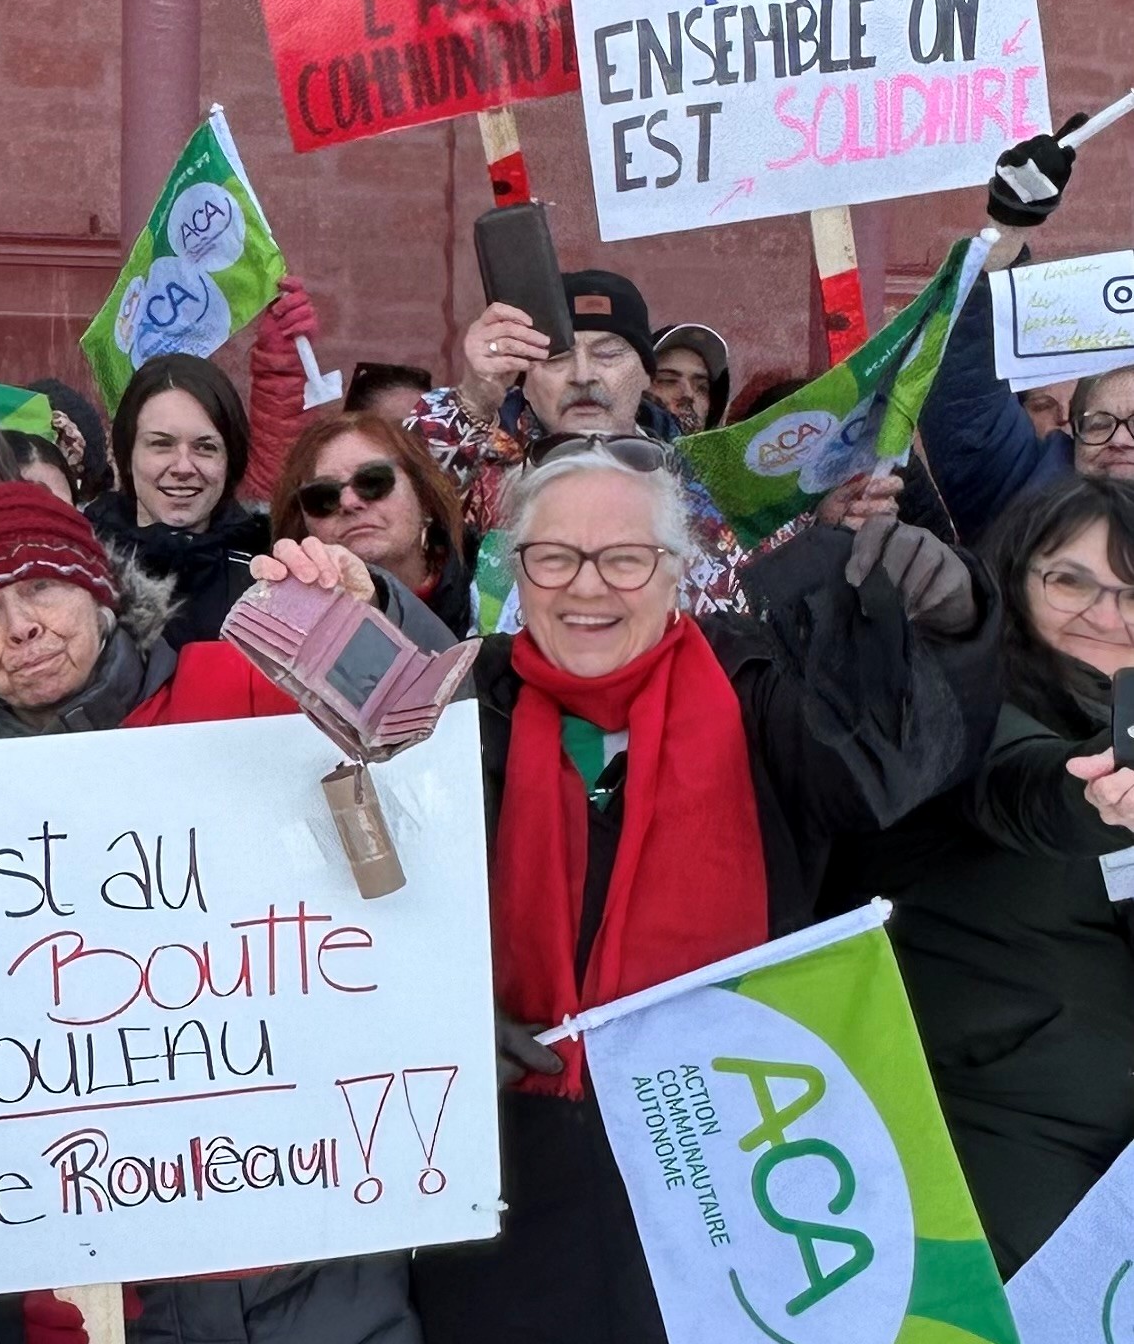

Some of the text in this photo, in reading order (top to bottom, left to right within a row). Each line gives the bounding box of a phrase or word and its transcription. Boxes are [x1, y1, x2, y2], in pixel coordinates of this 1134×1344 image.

[611, 66, 1042, 193] EST SOLIDAIRE
[179, 199, 226, 249] ACA
[100, 826, 210, 915] au
[8, 901, 380, 1026] Boutte
[631, 1076, 686, 1191] AUTONOME
[656, 1069, 731, 1248] COMMUNAUTAIRE
[679, 1064, 722, 1136] ACTION
[710, 1056, 876, 1318] ACA
